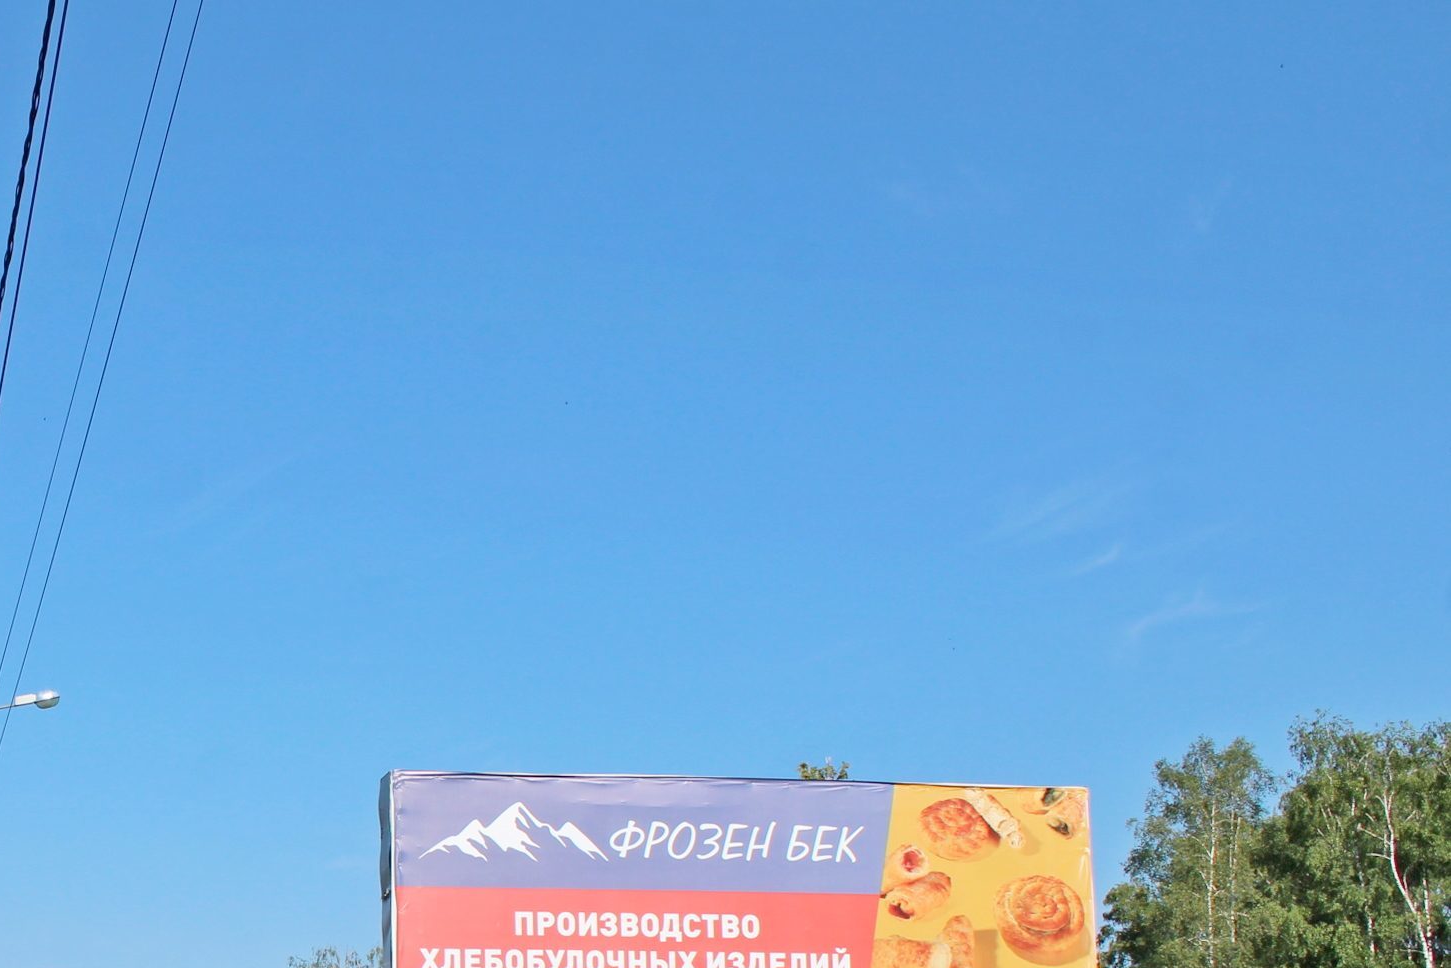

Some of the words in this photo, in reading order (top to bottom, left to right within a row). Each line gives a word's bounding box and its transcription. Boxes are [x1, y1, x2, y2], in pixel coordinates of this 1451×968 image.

[609, 819, 776, 862] ФРОЗЕН
[786, 825, 864, 864] БЕК
[514, 911, 761, 942] ПРОИЗВОДСТВО
